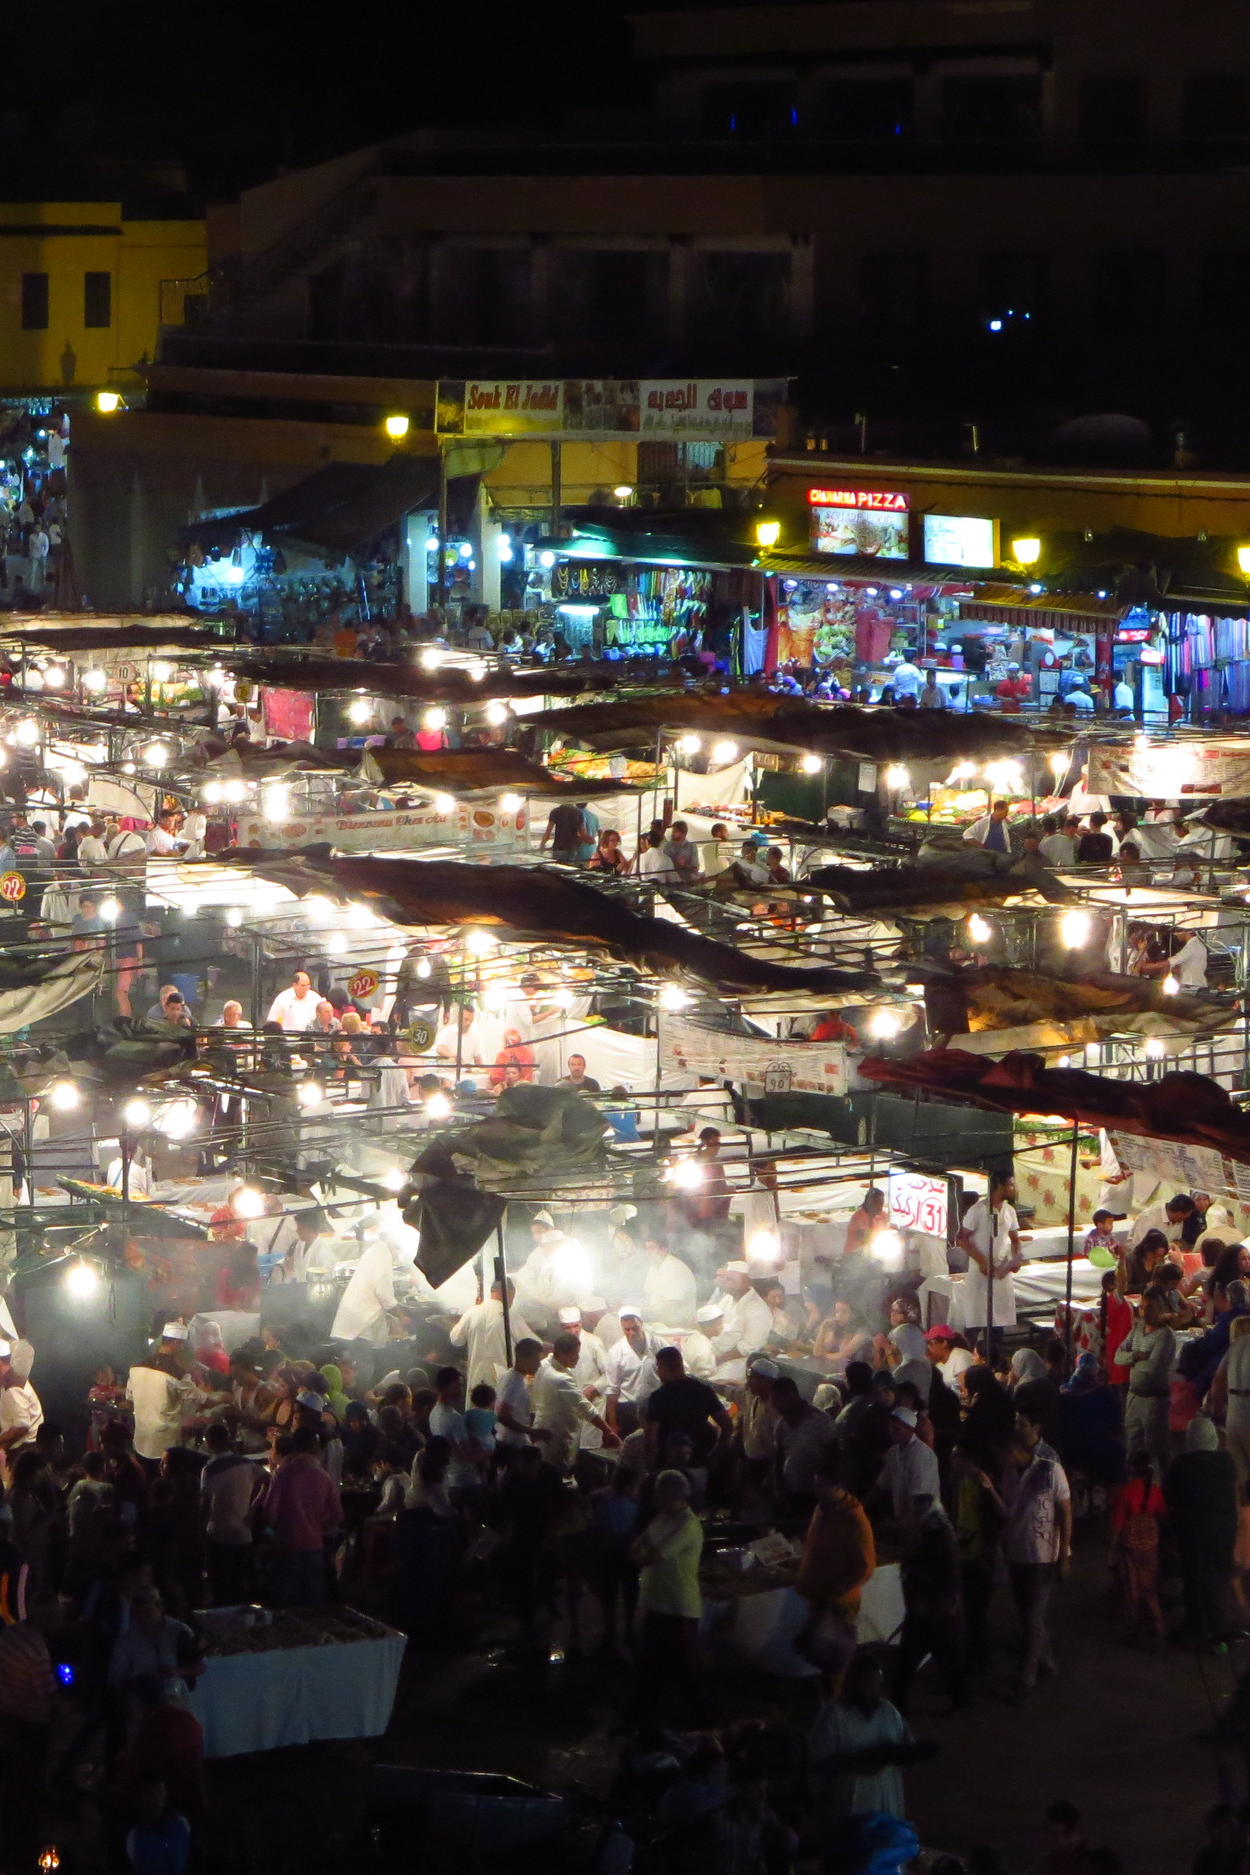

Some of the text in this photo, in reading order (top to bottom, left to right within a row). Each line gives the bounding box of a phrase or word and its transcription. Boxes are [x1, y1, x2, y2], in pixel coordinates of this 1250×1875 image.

[468, 384, 501, 410] Souk
[503, 384, 520, 410] El
[857, 492, 906, 509] PIZZA
[119, 666, 129, 679] 10
[3, 878, 20, 898] 22
[354, 976, 374, 996] 22
[413, 1028, 428, 1044] 30
[770, 1079, 785, 1091] 90
[924, 1203, 943, 1233] 31
